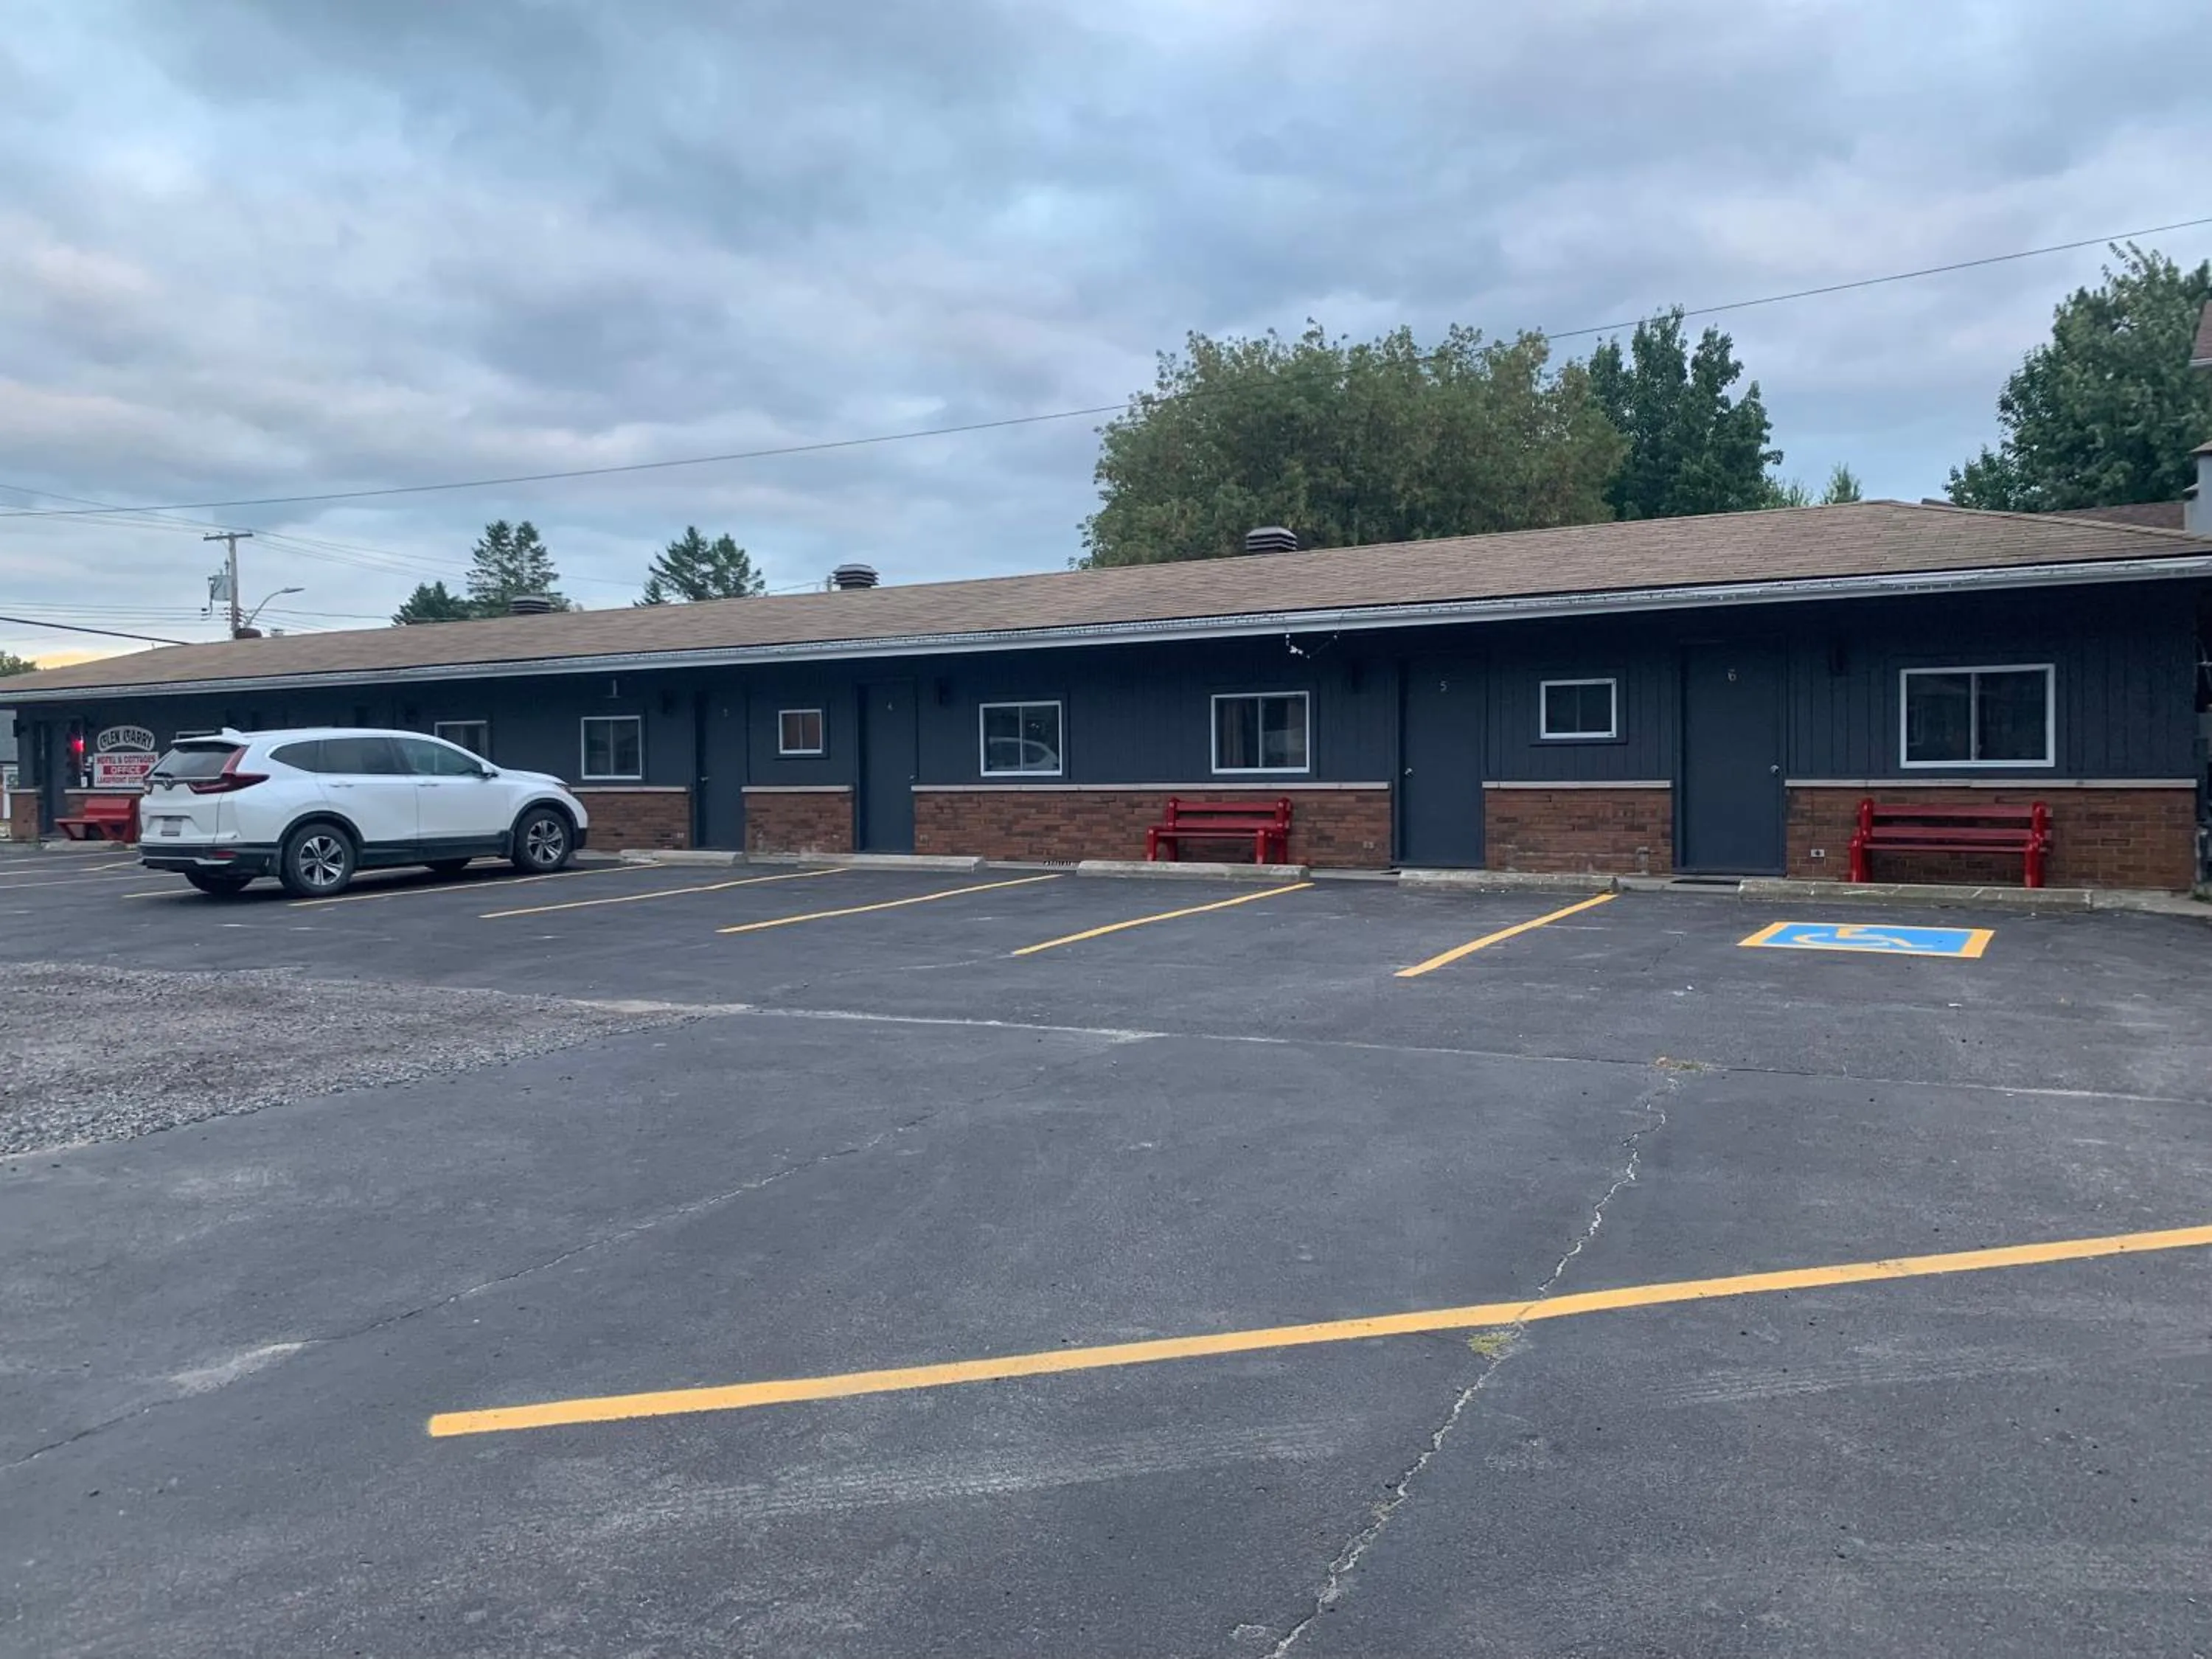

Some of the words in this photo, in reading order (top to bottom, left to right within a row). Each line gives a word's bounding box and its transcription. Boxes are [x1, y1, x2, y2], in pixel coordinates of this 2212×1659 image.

[1440, 681, 1447, 692] 5
[100, 731, 120, 748] GLEN
[123, 729, 152, 748] GARRY
[124, 754, 156, 764] COTTAGES
[111, 765, 140, 774] OFFICE
